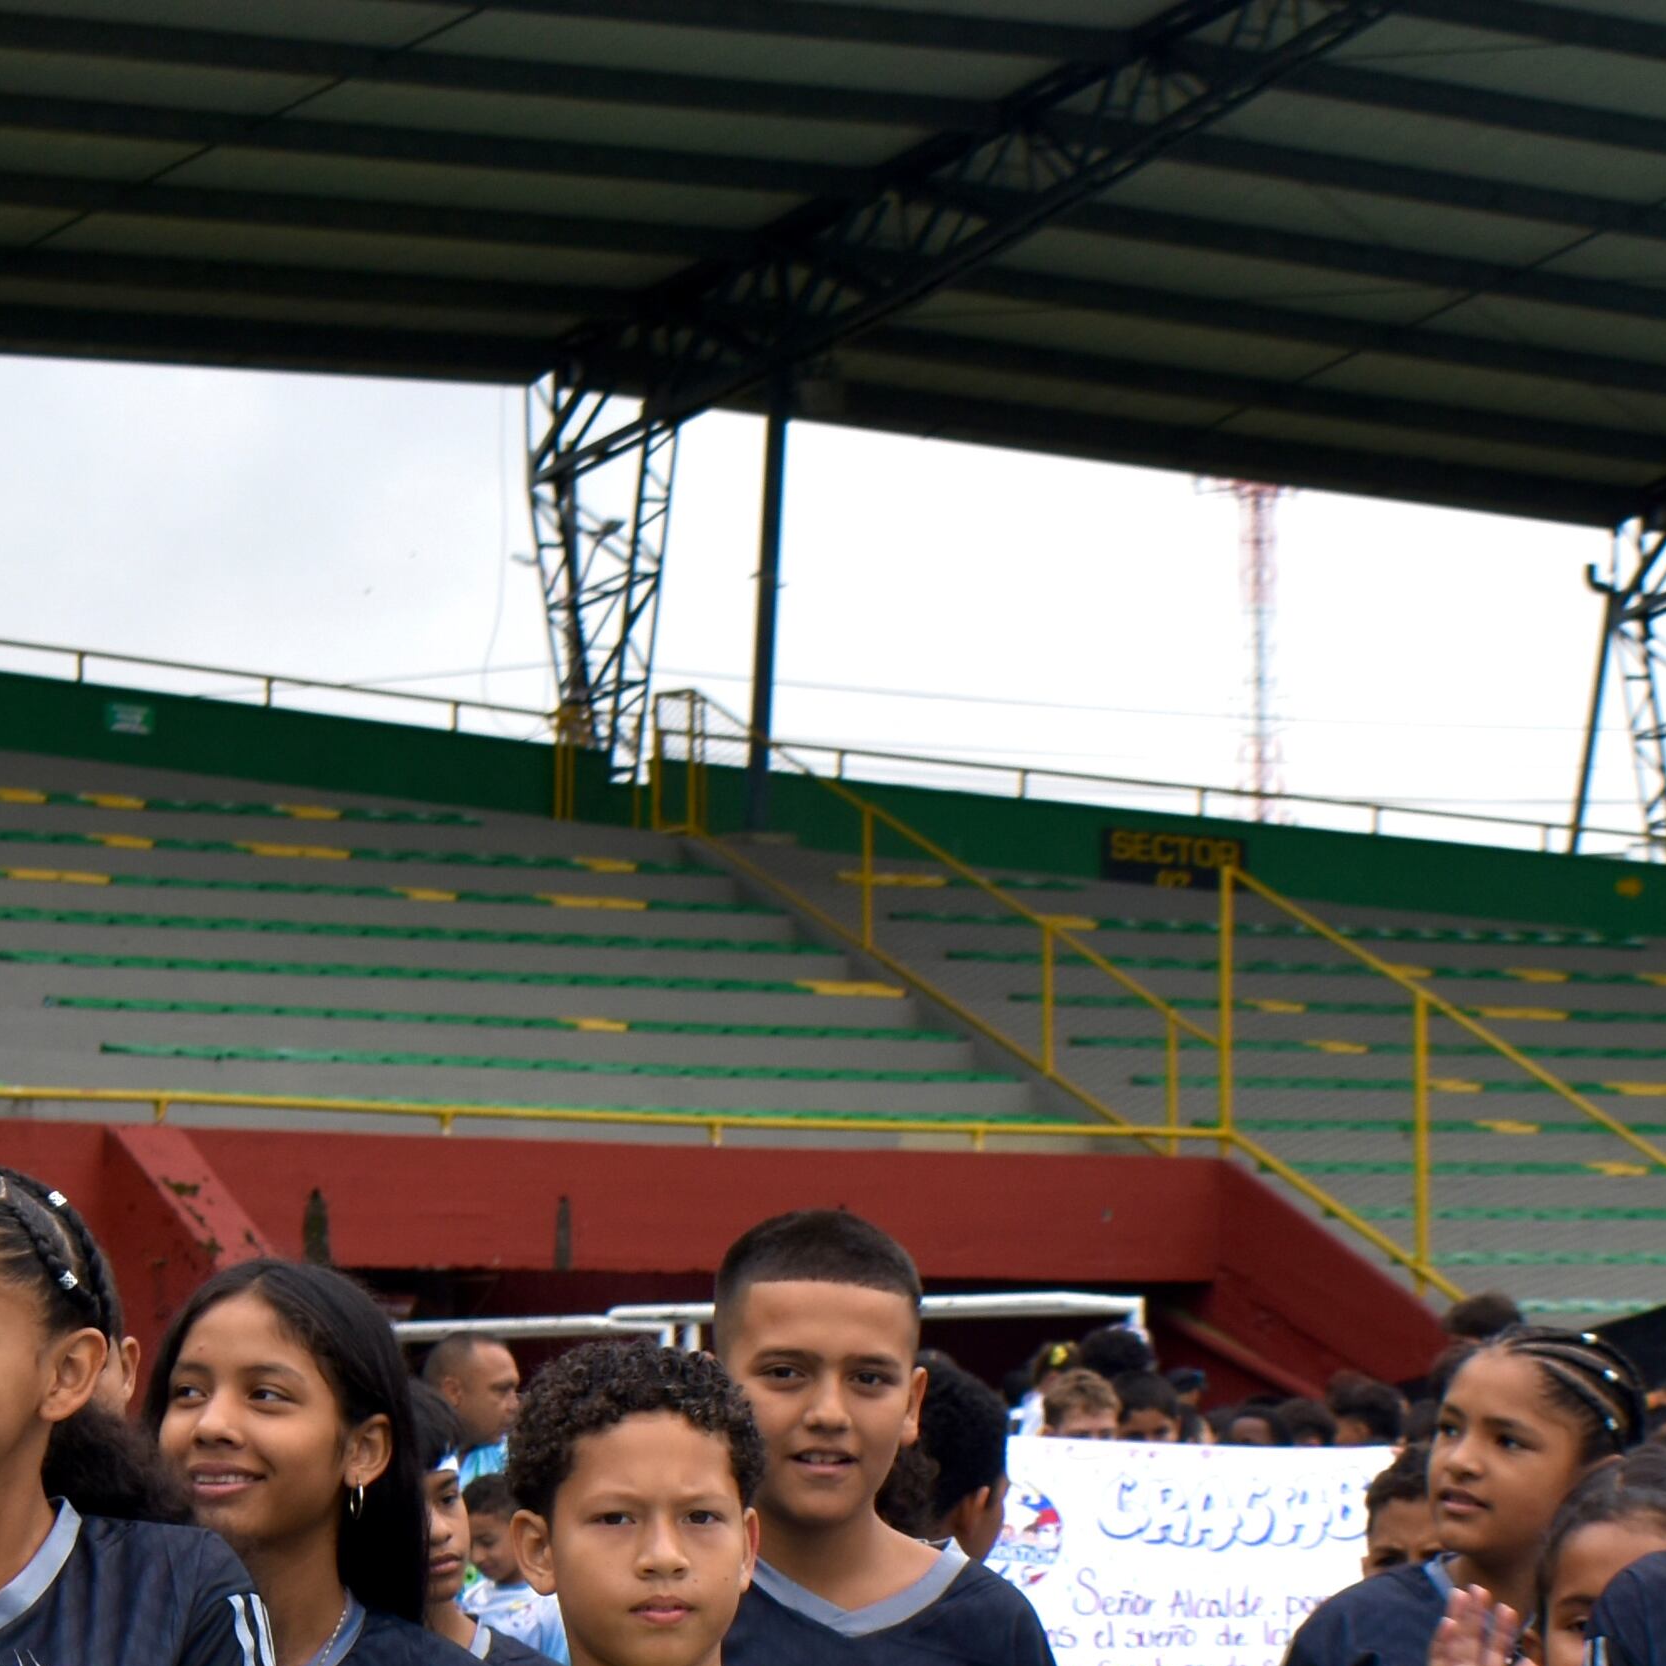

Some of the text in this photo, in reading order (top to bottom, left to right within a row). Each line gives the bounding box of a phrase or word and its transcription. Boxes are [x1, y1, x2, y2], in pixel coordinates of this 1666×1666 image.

[1110, 830, 1240, 869] SECTOR
[1073, 1566, 1156, 1616] Señor
[1093, 1620, 1116, 1650] el
[1124, 1623, 1198, 1650] sueño
[1215, 1623, 1249, 1648] de
